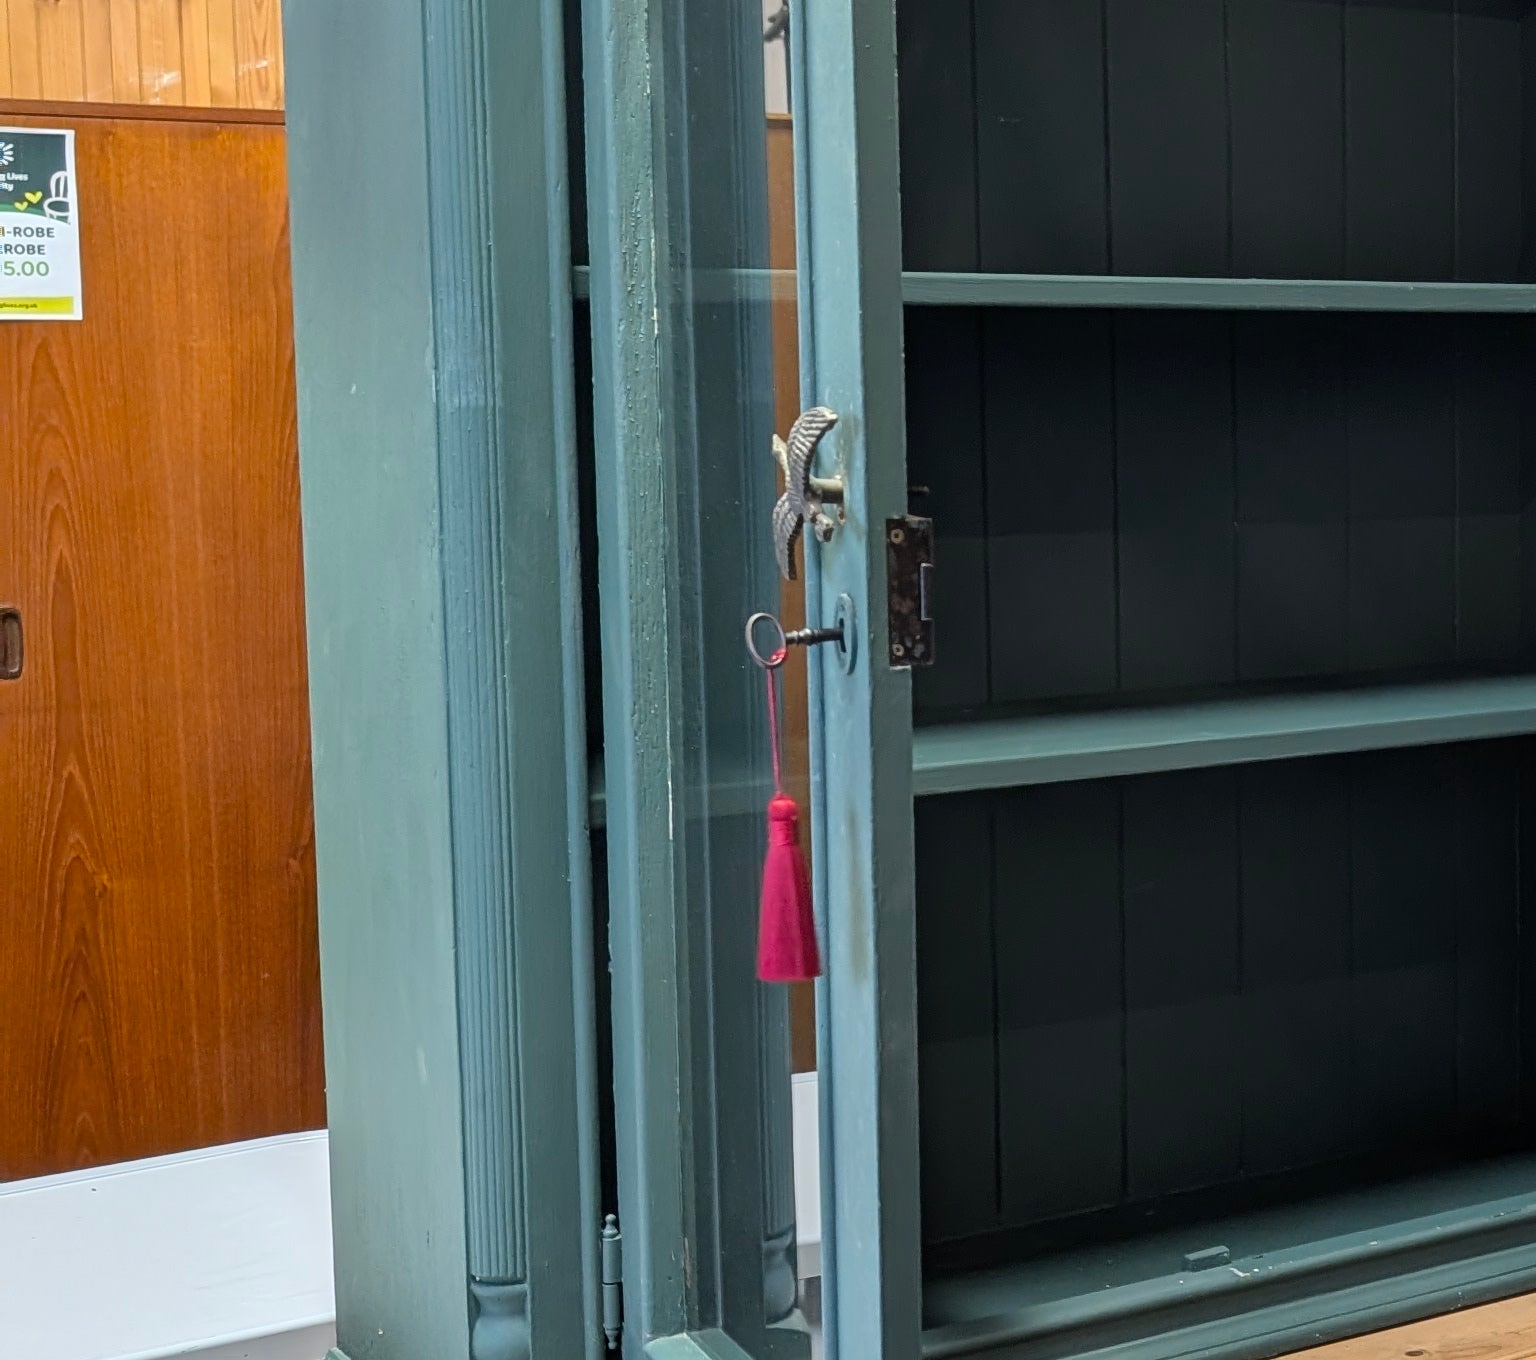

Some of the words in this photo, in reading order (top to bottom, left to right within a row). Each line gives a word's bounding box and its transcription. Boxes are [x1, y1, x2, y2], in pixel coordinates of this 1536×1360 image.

[6, 172, 29, 181] Lives
[0, 226, 55, 238] I-ROBE
[0, 261, 49, 276] 5.00
